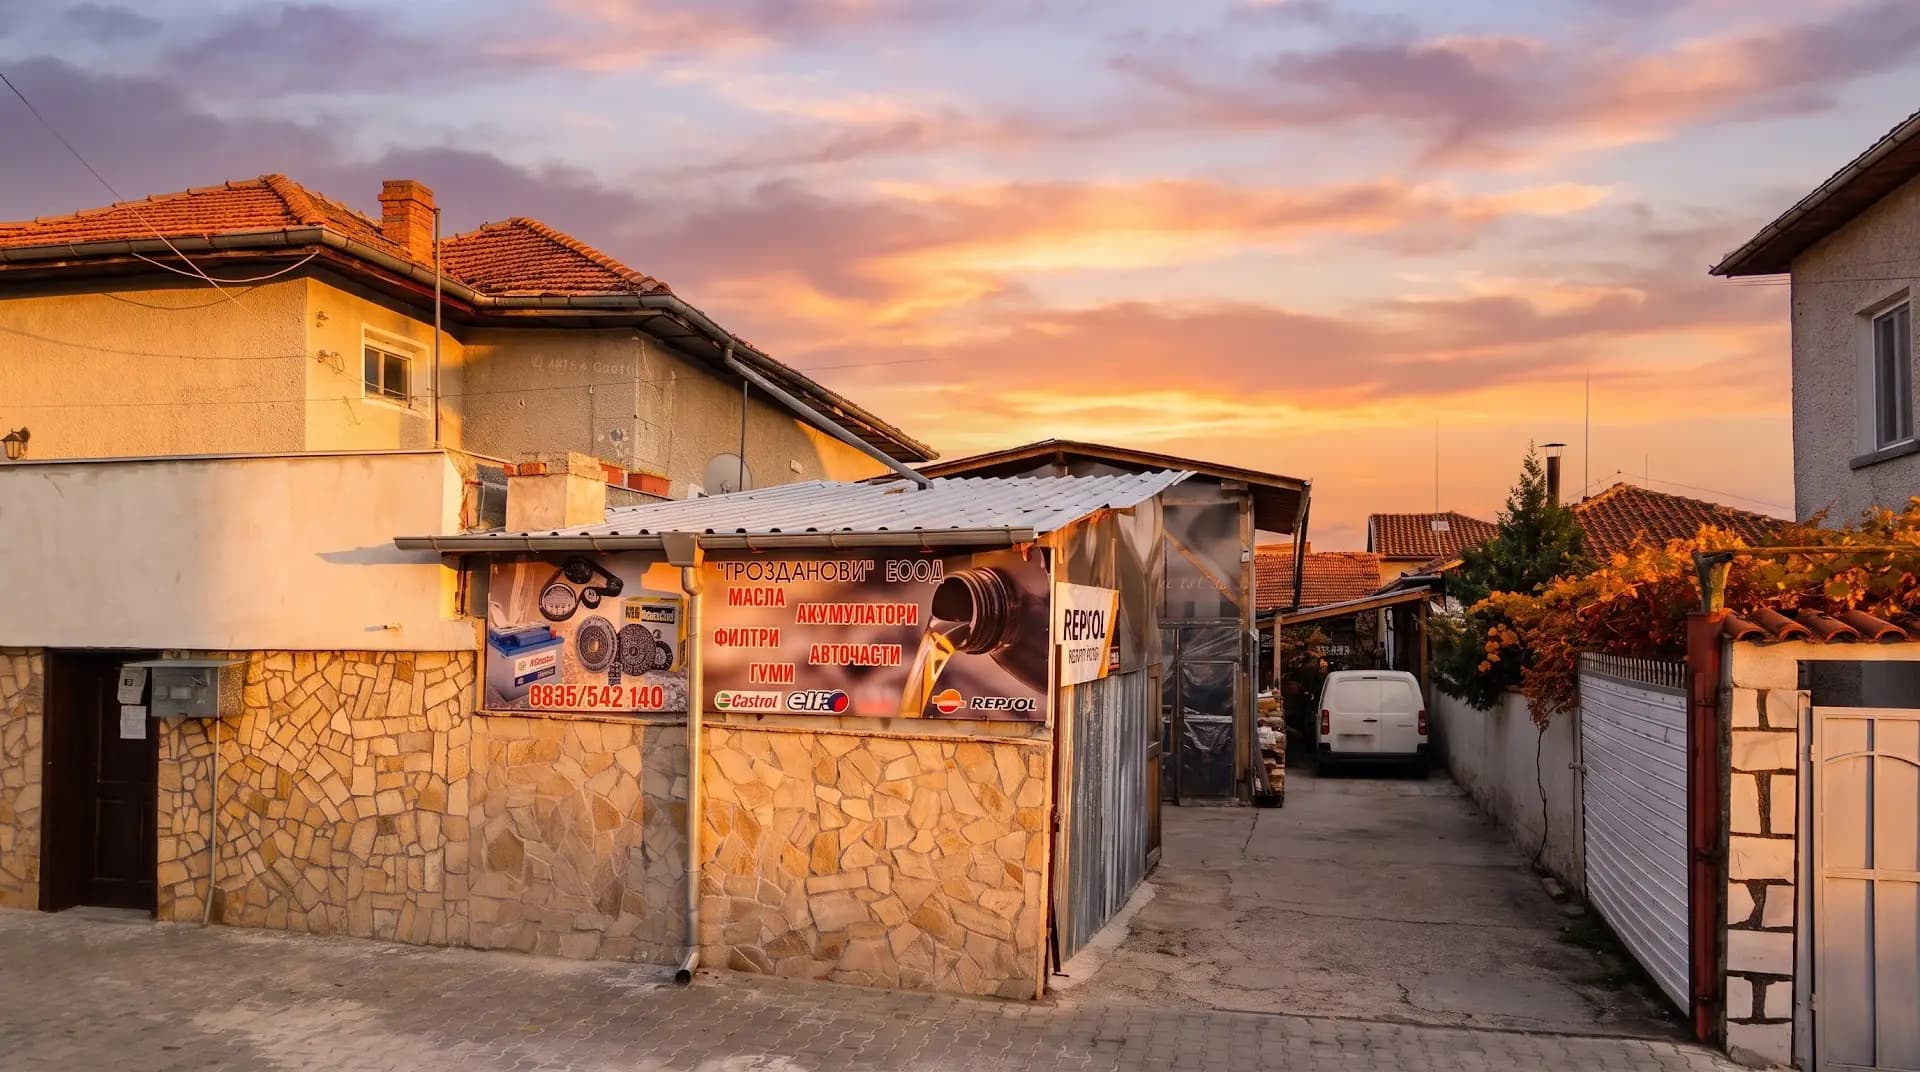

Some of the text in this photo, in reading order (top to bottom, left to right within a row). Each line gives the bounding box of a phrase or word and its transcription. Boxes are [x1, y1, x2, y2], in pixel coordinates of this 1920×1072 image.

[717, 560, 944, 584] "ГРОЗДАНОВИ" ЕООД
[728, 587, 786, 607] МАСЛА
[796, 602, 918, 626] АКУМУЛАТОРИ
[1063, 609, 1105, 640] REPSOL
[714, 628, 780, 648] ФИЛТРИ
[809, 644, 901, 666] АВТОЧАСТИ
[749, 663, 796, 684] ГУМИ
[629, 685, 664, 709] 140
[732, 693, 778, 708] Castrol
[970, 696, 1037, 711] REPSOL
